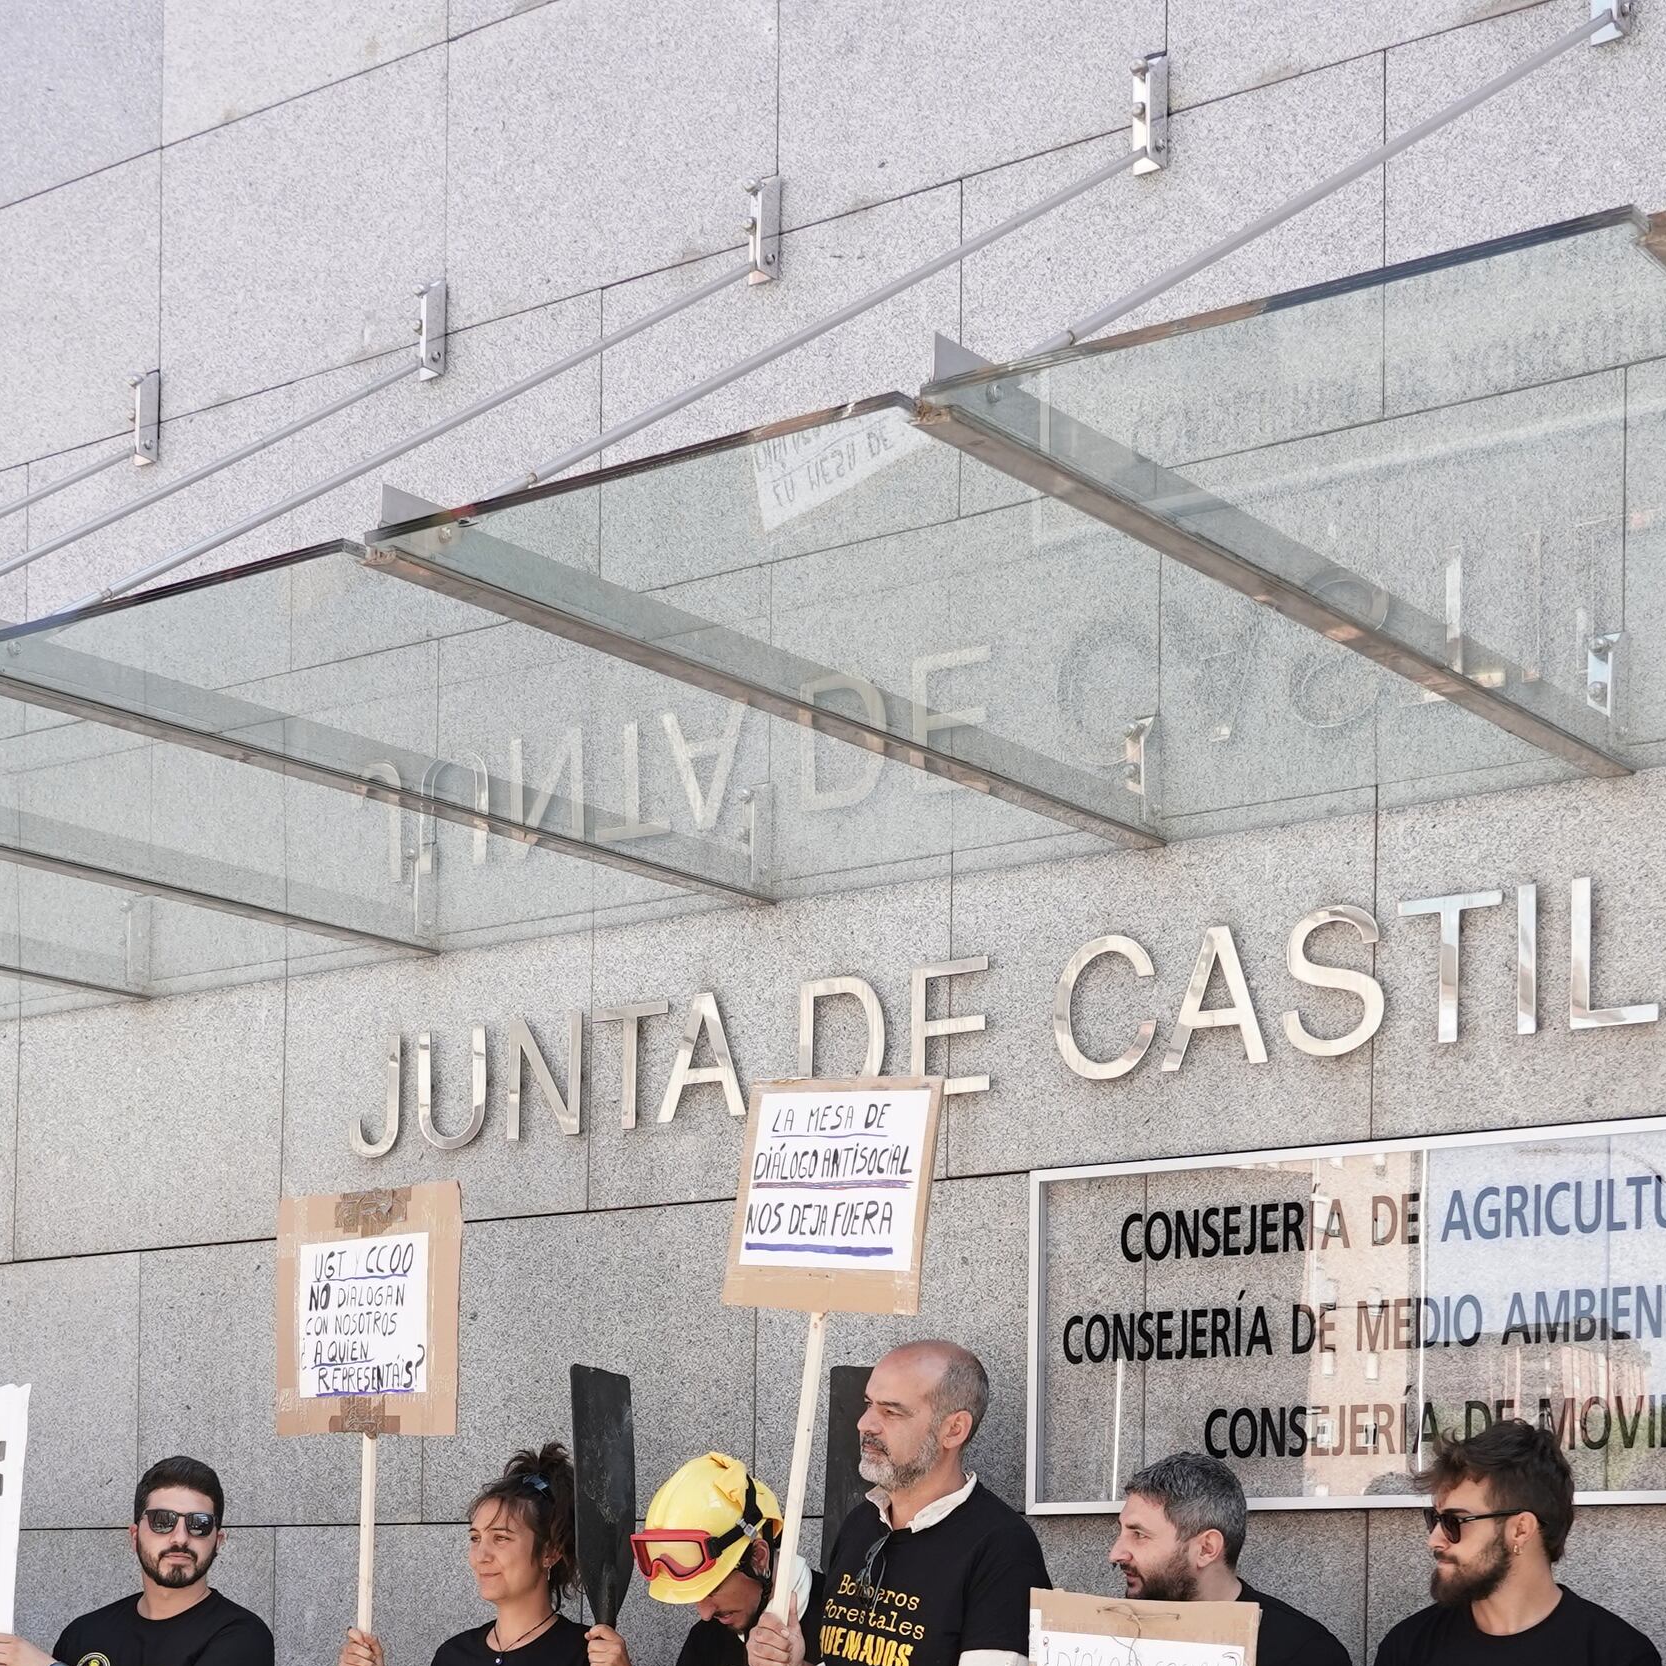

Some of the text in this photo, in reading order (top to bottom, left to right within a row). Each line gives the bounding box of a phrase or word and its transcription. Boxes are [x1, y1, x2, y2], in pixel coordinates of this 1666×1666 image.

[349, 992, 747, 1159] JUNTA
[797, 955, 991, 1096] DE
[771, 1103, 892, 1133] LA MESA DE
[753, 1142, 913, 1181] DIÁLOGO ANTISOCIAL
[745, 1200, 894, 1237] NOS DEJA FUERA
[1370, 1192, 1421, 1246] DE
[314, 1251, 348, 1282] UGT
[365, 1243, 414, 1274] CCOO
[308, 1282, 331, 1312] NO
[305, 1311, 398, 1337] CON NOSOTROS
[1062, 1290, 1274, 1364] CONSEJERÍA
[1291, 1303, 1337, 1356] DE
[1355, 1293, 1483, 1353] MEDIO
[1204, 1385, 1438, 1460] CONSEJERÍA
